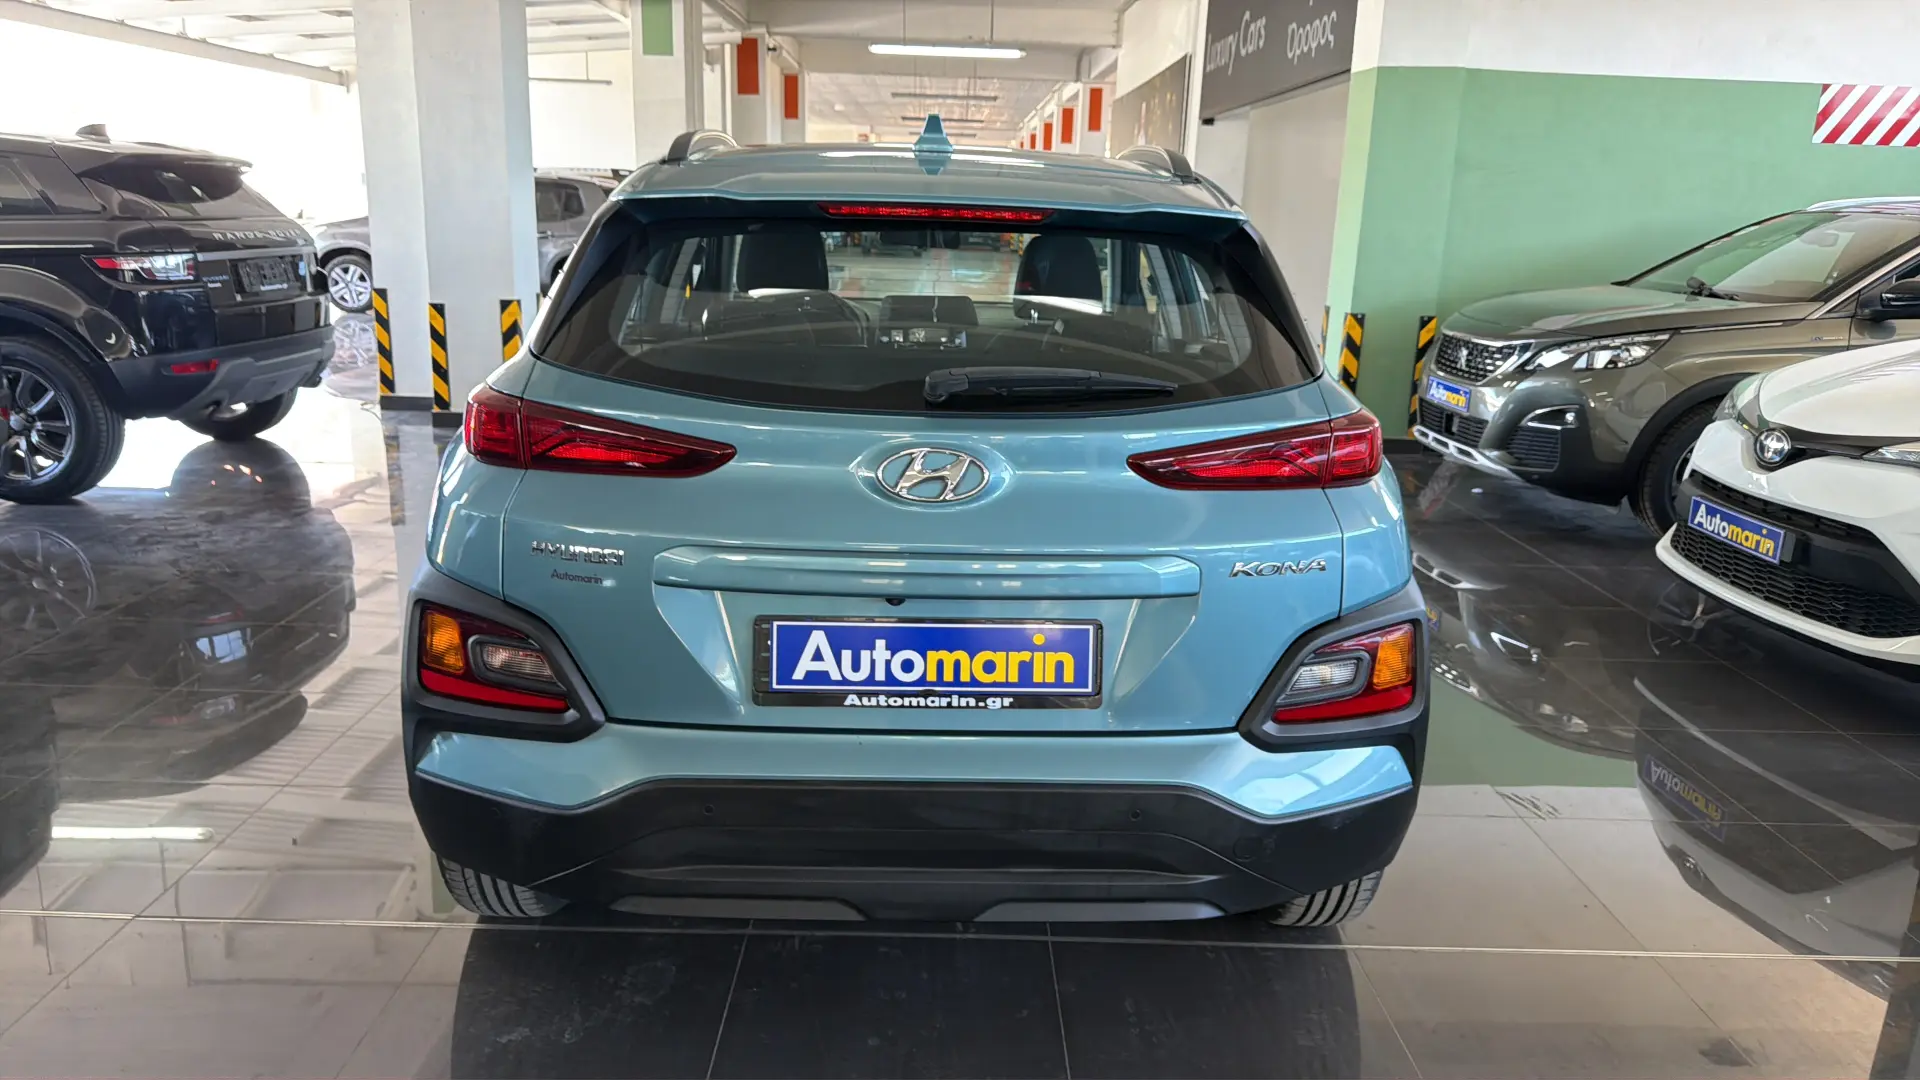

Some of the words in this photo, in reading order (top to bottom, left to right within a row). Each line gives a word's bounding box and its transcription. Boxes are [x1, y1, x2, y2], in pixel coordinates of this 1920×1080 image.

[1205, 31, 1238, 76] Luxury
[1239, 10, 1266, 57] Cars
[1693, 503, 1775, 557] Automarin
[530, 540, 625, 567] HYUNDAI
[550, 568, 604, 585] Automarin
[1229, 558, 1327, 578] KONA
[791, 629, 1075, 684] Automarin
[843, 693, 1014, 710] Automarin.gr
